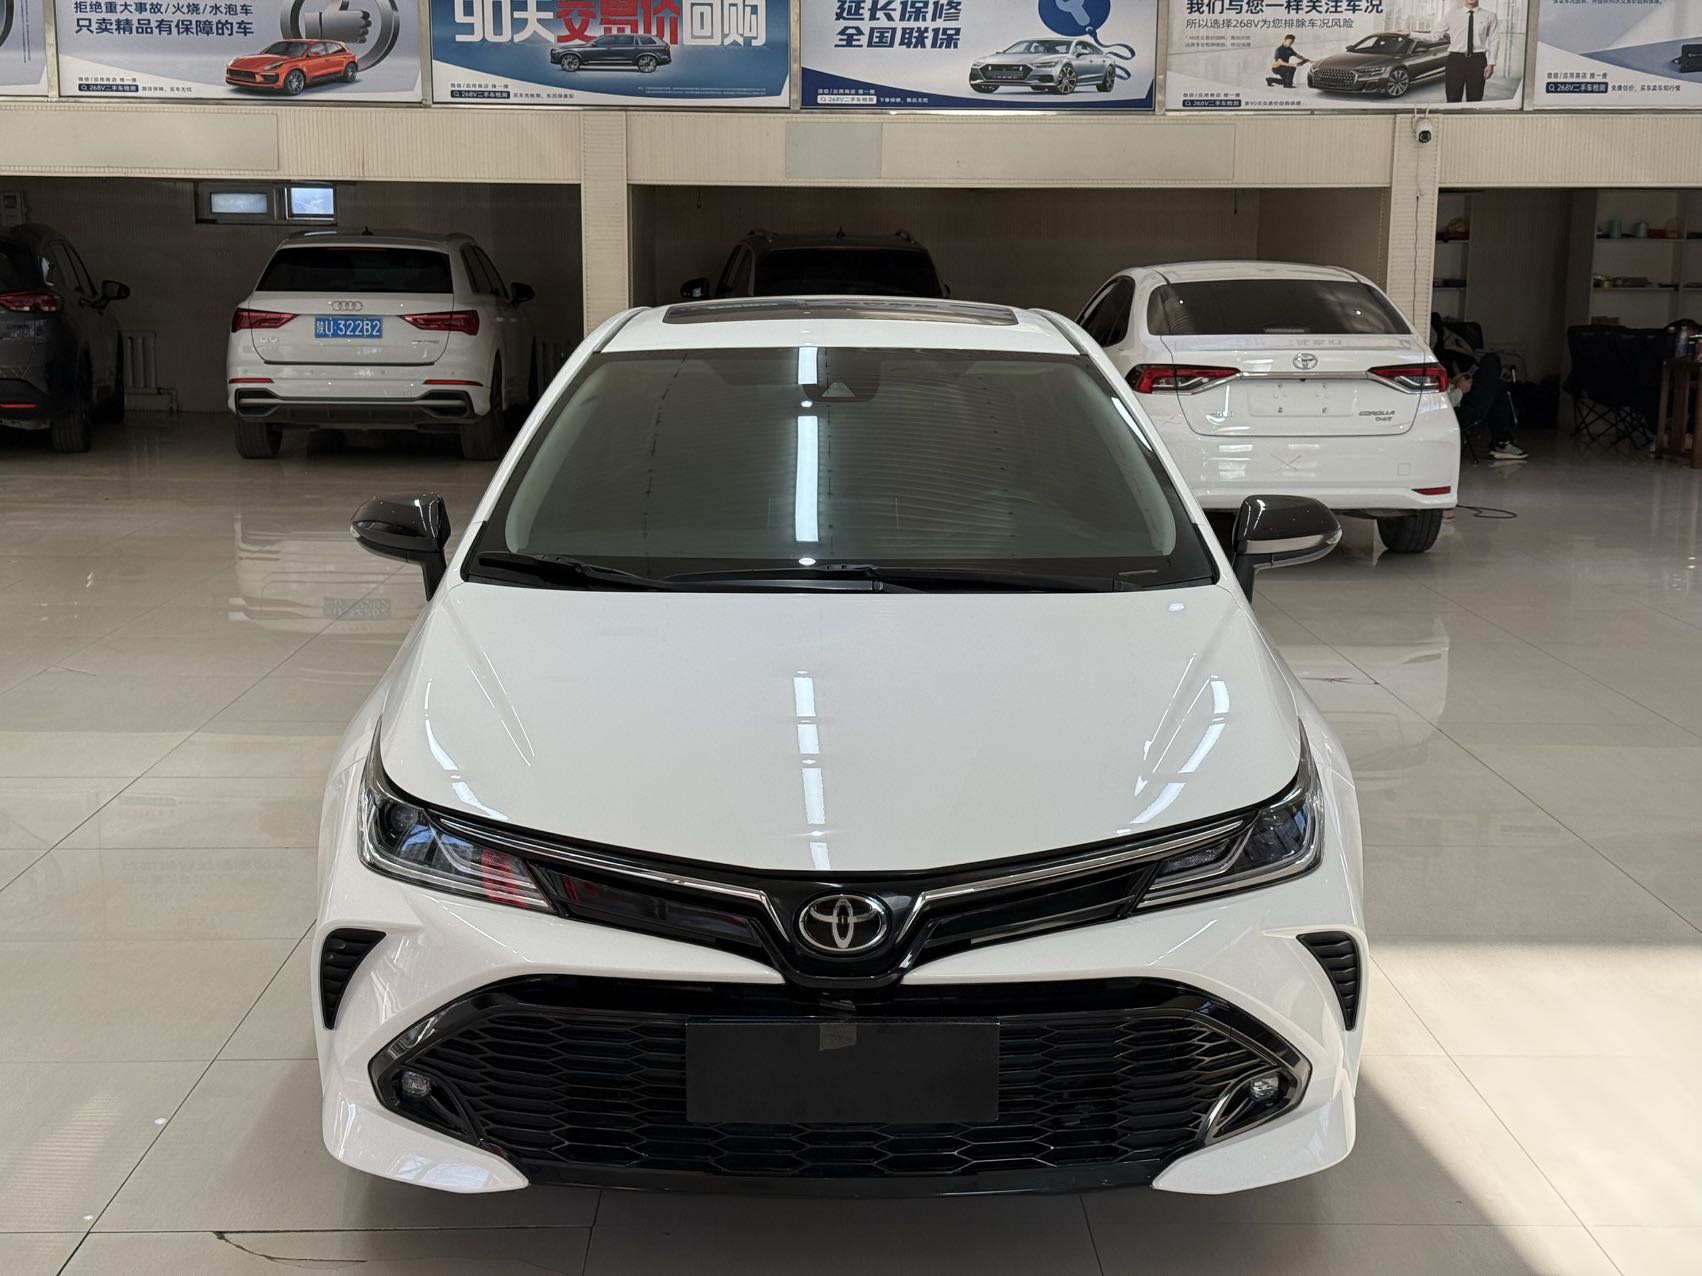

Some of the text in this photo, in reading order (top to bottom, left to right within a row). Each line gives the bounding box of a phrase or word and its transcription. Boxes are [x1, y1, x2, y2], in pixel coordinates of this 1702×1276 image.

[74, 1, 253, 16] 拒绝重大事故/火烧/水泡车
[834, 0, 962, 22] 延长保修
[1186, 0, 1384, 14] 我们与您一样关注车况
[75, 18, 254, 36] 只卖精品有保障的车
[1185, 18, 1354, 29] 所以选择268V为您排除车况风险
[834, 26, 962, 49] 全国联保
